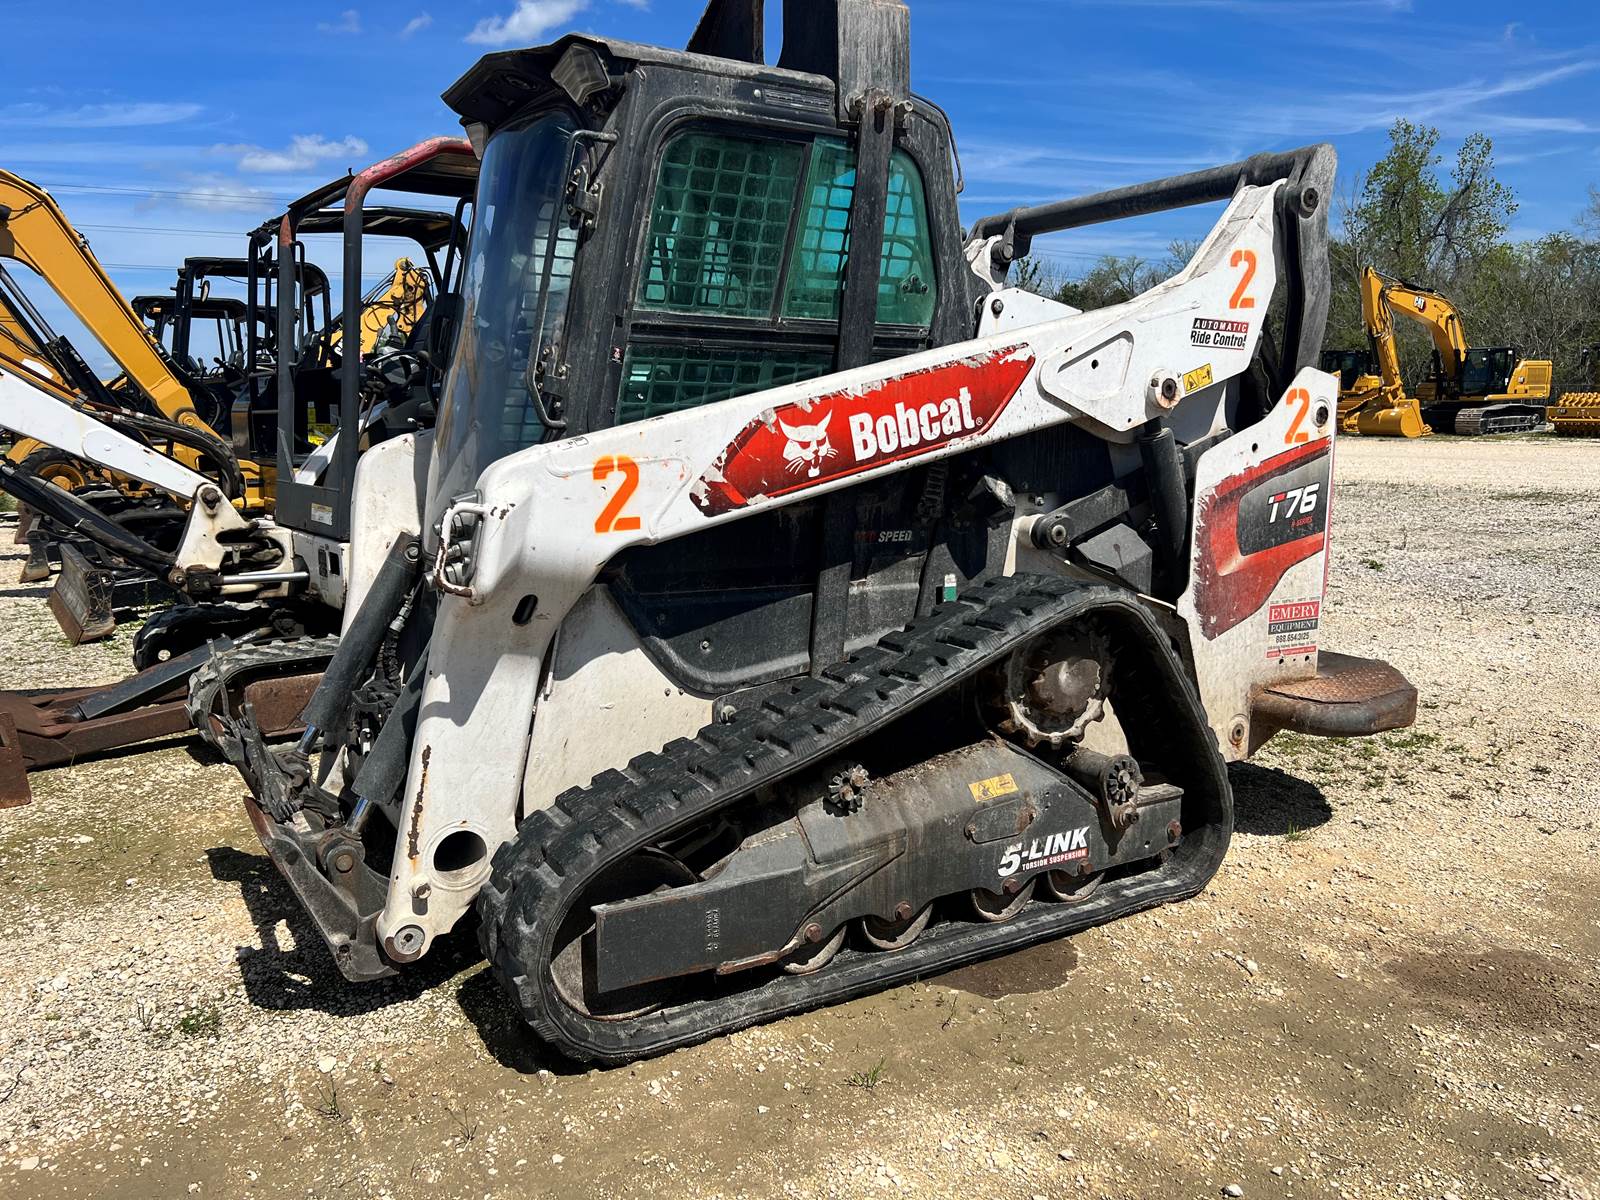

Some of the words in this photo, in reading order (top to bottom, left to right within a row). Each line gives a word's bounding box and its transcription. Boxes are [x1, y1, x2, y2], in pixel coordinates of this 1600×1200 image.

[1229, 249, 1257, 309] 2
[1190, 330, 1211, 345] Ride
[1194, 320, 1248, 333] AUTOMATIC
[848, 386, 976, 462] Bobcat
[1285, 388, 1310, 444] 2
[593, 454, 641, 534] 2
[1267, 482, 1320, 524] T76
[878, 530, 913, 542] SPEED
[1270, 620, 1316, 633] EQUIPMENT
[1271, 604, 1318, 621] EMERY
[997, 826, 1090, 877] 5-LINK
[1022, 859, 1048, 871] TORSION
[1049, 849, 1087, 865] SUSPENSION
